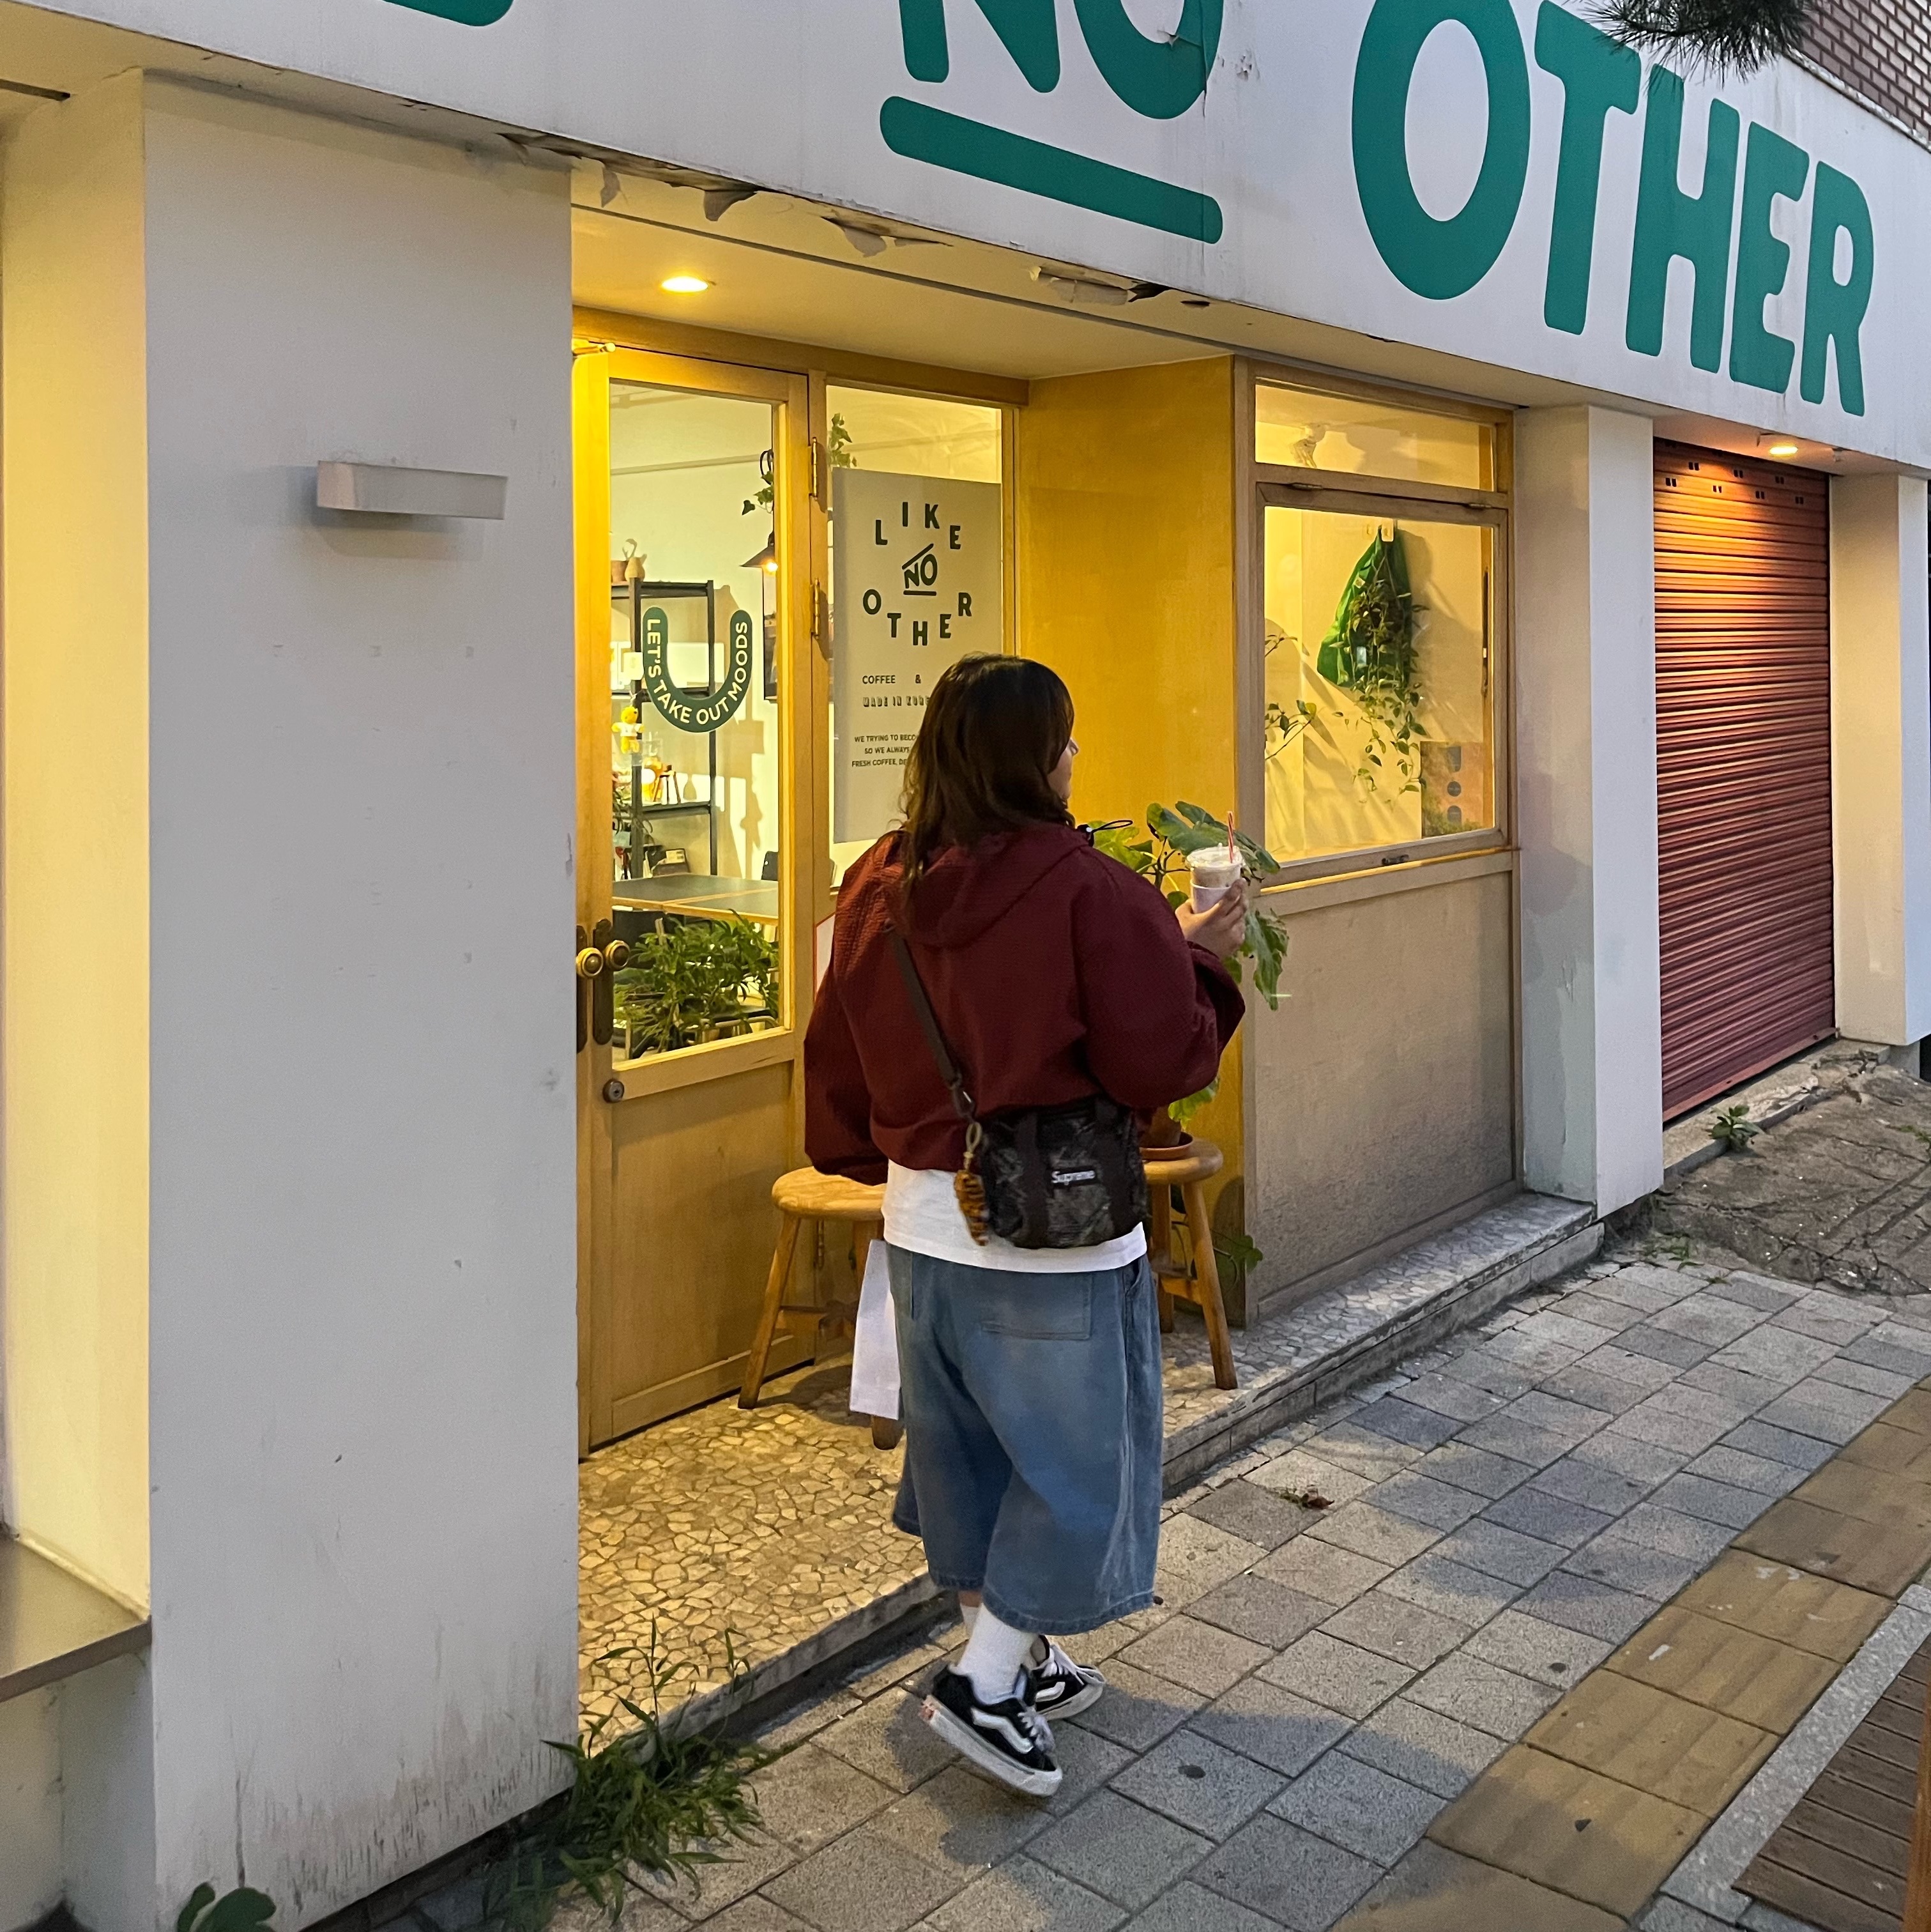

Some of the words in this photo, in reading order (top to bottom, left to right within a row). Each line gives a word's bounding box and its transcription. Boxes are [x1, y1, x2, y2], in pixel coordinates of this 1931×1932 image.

[1352, 0, 1874, 416] OTHER
[876, 502, 961, 549] LIKE
[904, 554, 938, 588] NO
[862, 589, 972, 646] OTHER
[647, 619, 661, 678] LET'S
[728, 622, 748, 702] MOODS
[653, 679, 692, 723] TAKE
[862, 675, 896, 684] COFFEE
[915, 675, 921, 684] &
[696, 697, 729, 724] OUT
